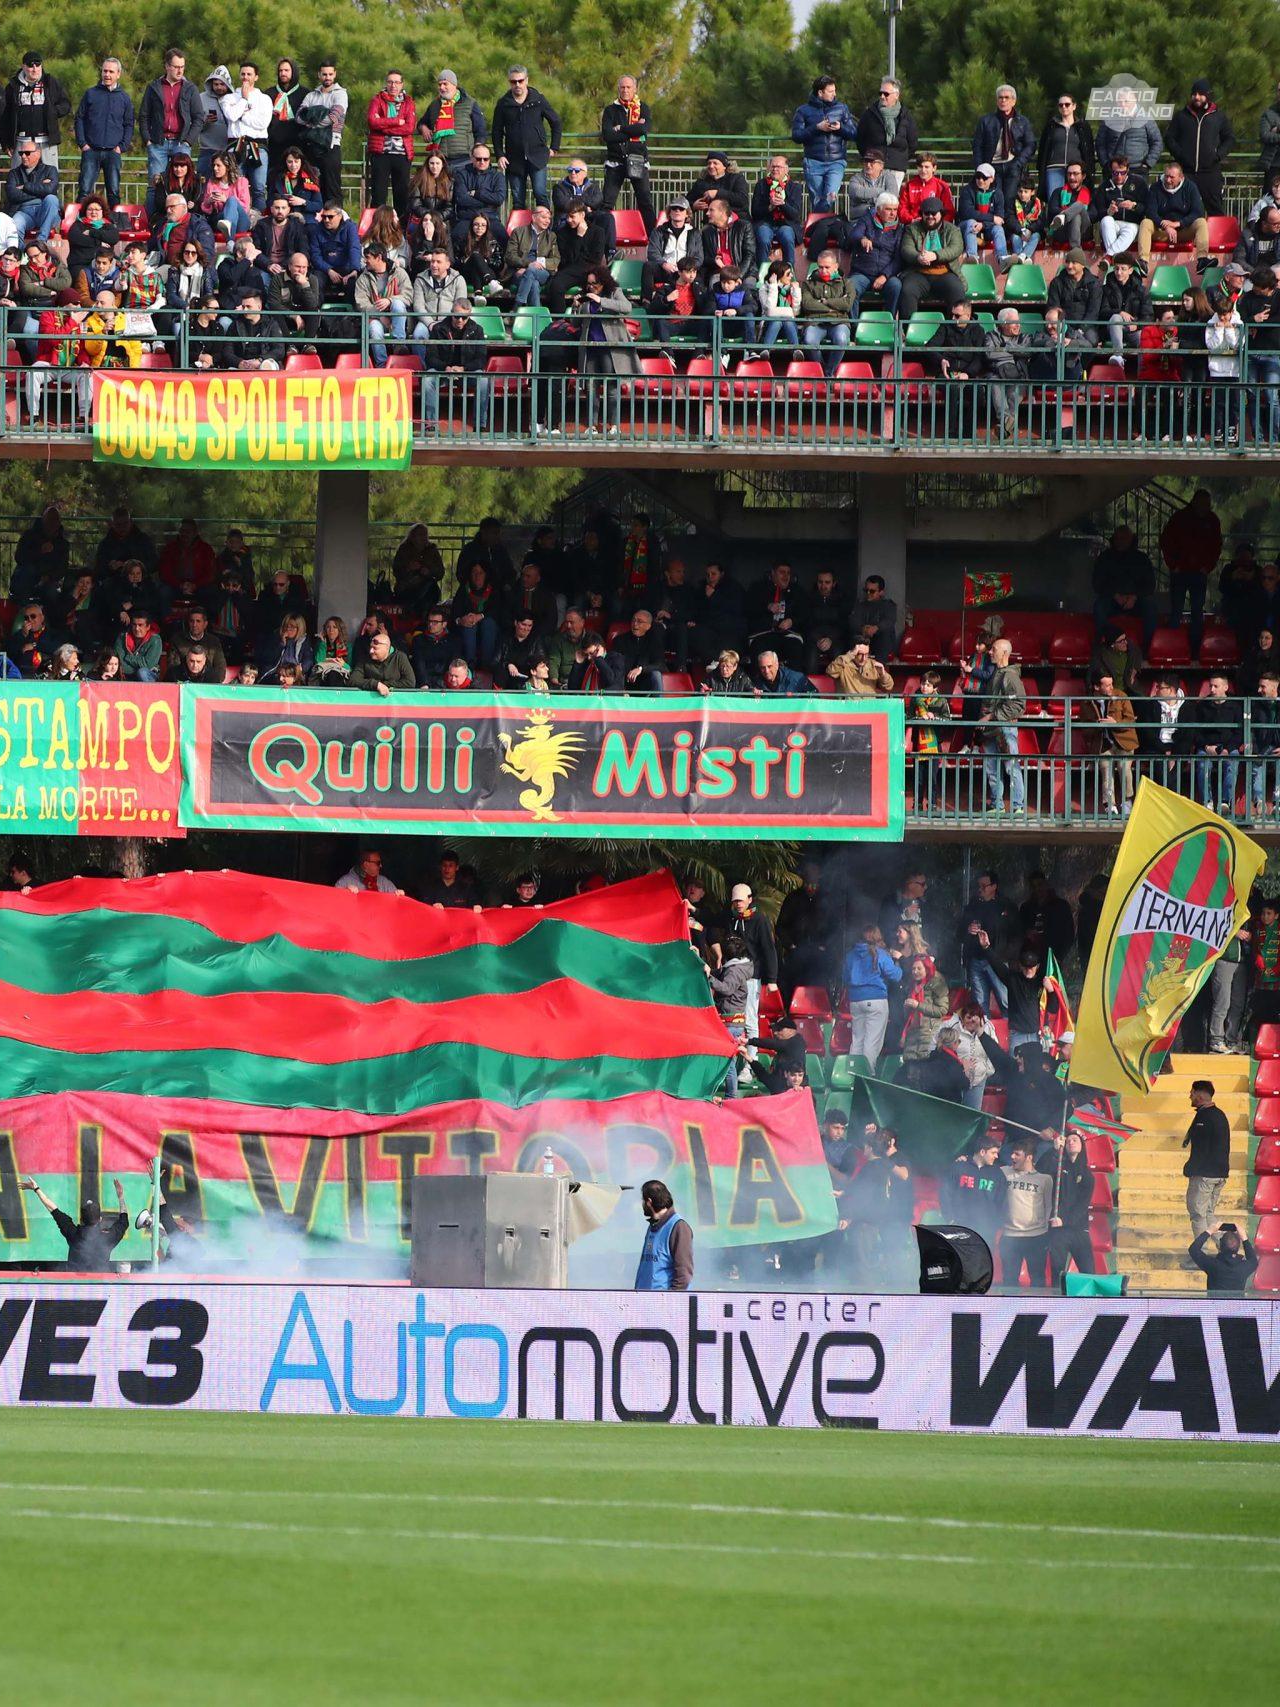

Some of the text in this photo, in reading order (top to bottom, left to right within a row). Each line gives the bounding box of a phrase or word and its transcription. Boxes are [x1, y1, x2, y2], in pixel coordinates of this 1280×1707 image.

[98, 376, 410, 462] 06049 SPOLETO (TR)
[38, 787, 172, 822] MORTE...
[247, 722, 806, 806] Quilli Misti
[118, 1298, 209, 1405] 3
[748, 1297, 883, 1324] center
[260, 1290, 886, 1429] Automotive
